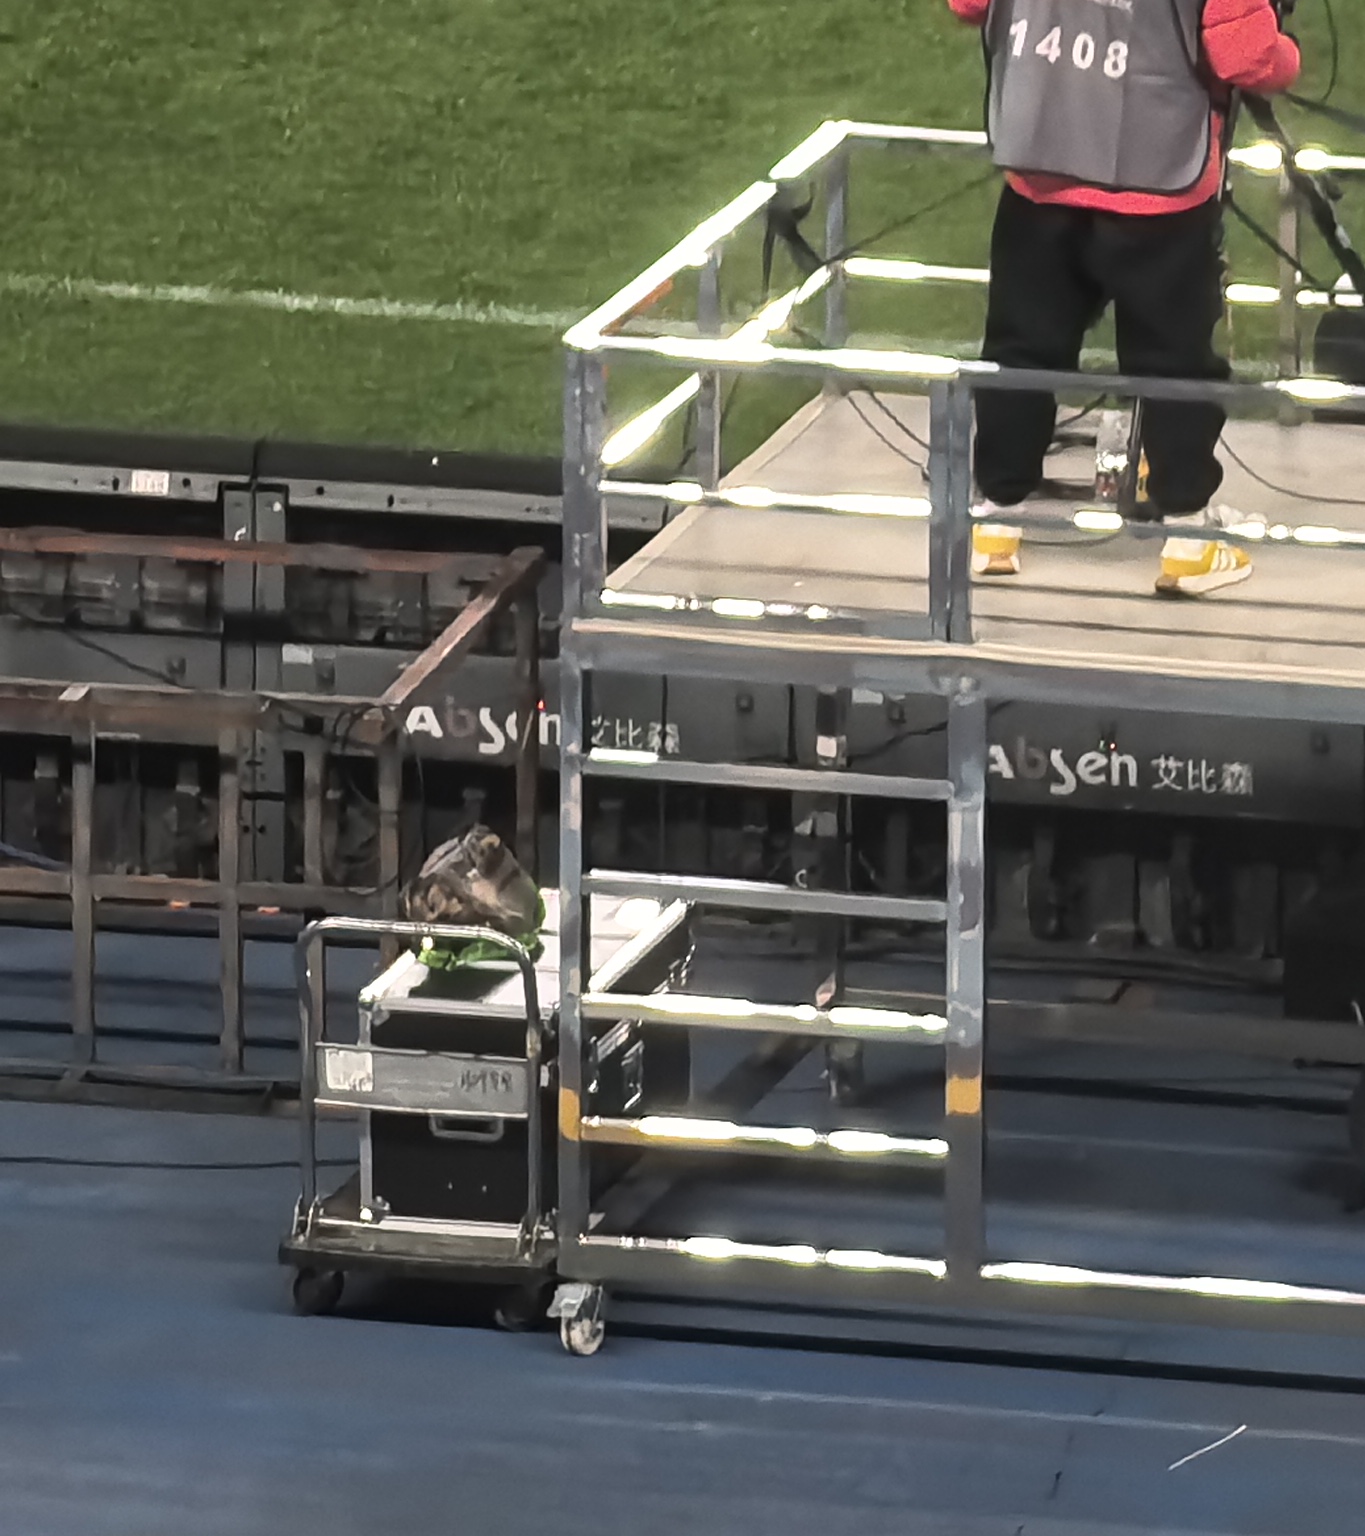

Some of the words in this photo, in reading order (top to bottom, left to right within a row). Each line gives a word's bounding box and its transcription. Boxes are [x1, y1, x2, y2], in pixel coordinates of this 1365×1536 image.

[1009, 19, 1129, 79] 1408
[1150, 753, 1254, 797] 艾比森
